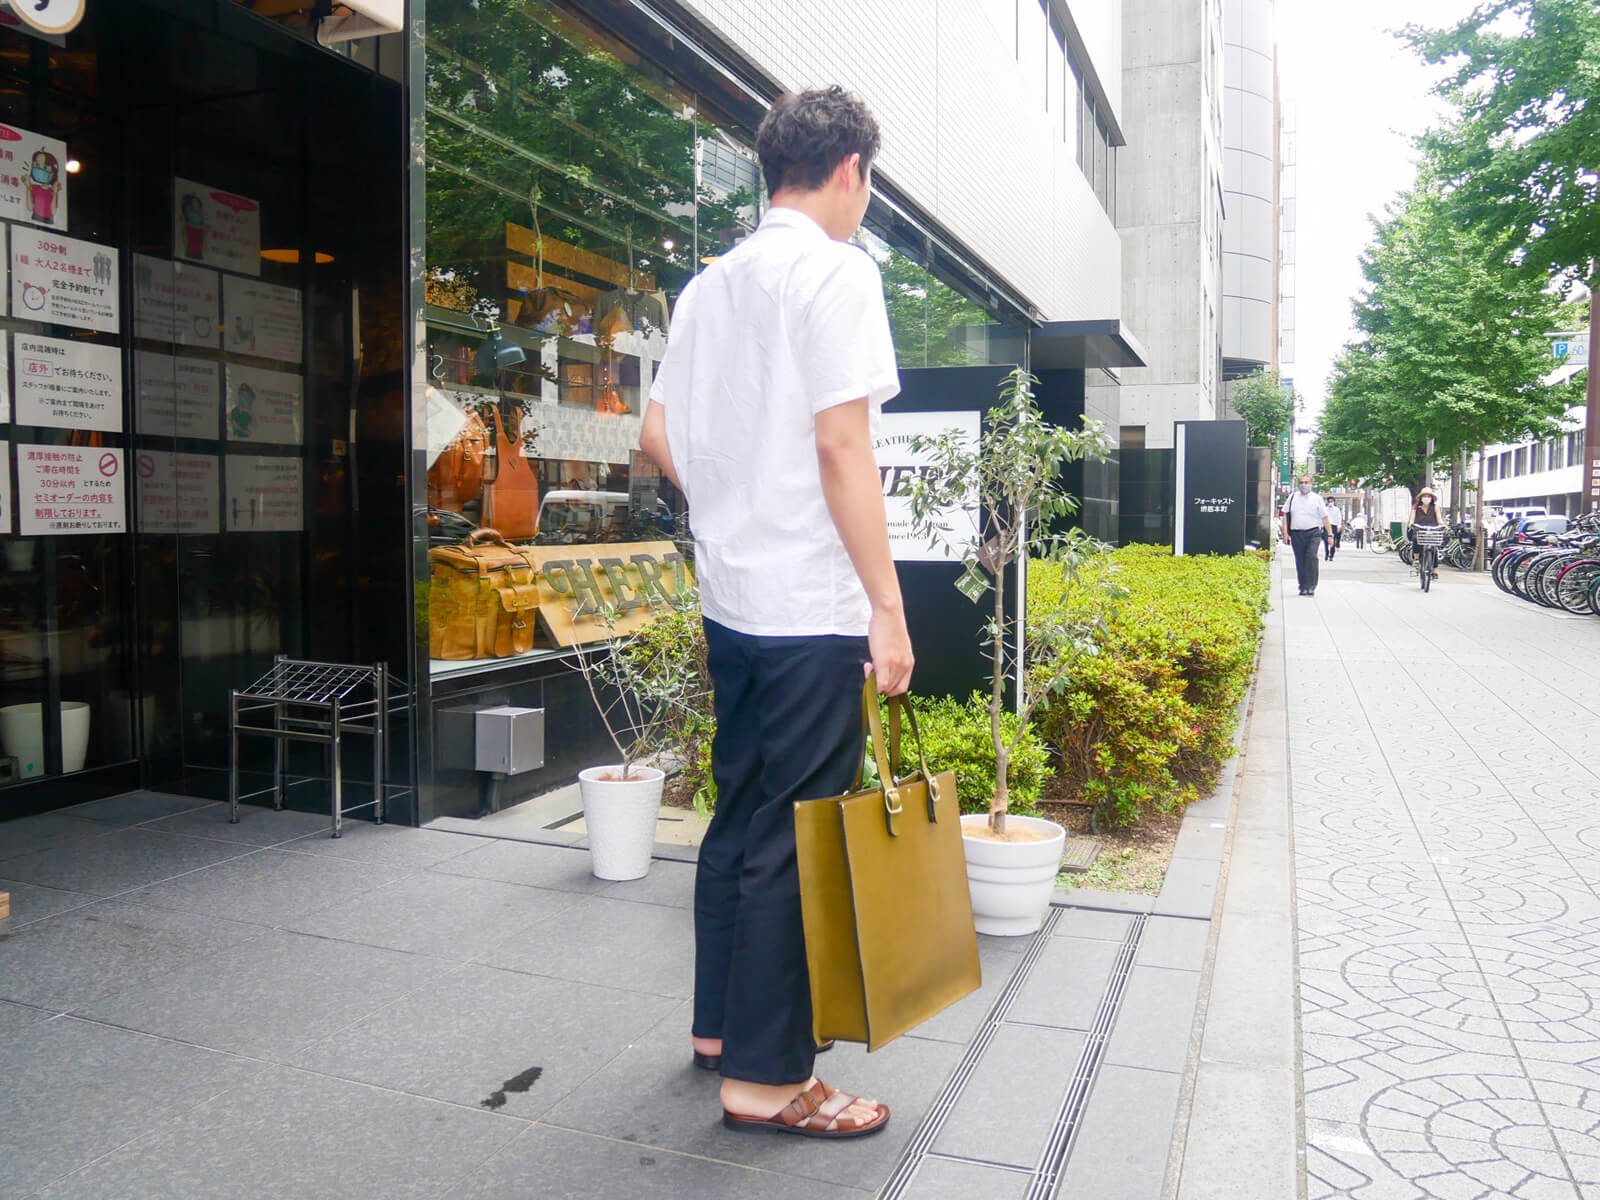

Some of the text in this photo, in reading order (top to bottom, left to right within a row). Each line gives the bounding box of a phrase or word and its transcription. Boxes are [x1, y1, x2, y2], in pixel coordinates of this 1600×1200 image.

[37, 240, 67, 256] 30分制
[35, 257, 92, 277] 大人2名様まで
[52, 279, 105, 297] 完全予約制です
[28, 361, 113, 382] 店外 でお待ちください。
[35, 465, 81, 475] ご滞在時間を
[40, 479, 112, 489] 30分以内 とするため
[34, 493, 113, 504] セミオーダーの内容を
[1194, 497, 1235, 505] フォーキャスト
[35, 508, 102, 519] 制限しております。
